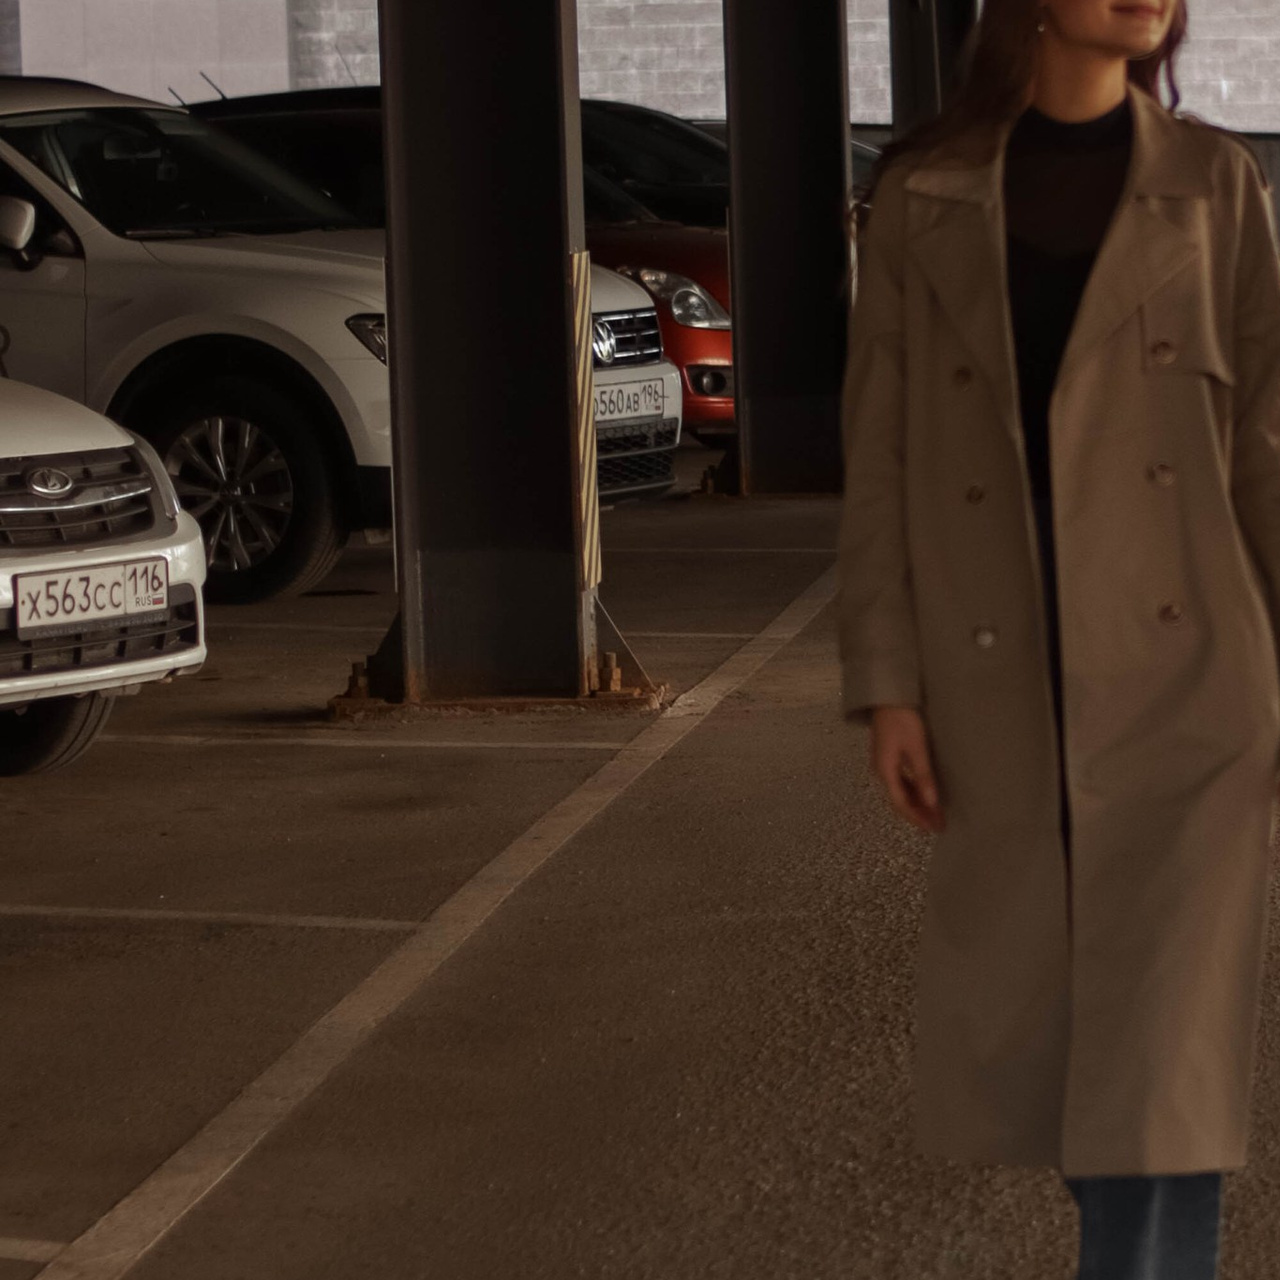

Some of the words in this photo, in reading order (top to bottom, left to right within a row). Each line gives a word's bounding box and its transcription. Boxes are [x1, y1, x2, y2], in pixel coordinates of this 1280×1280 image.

[642, 383, 659, 403] 196
[128, 564, 161, 595] 116
[135, 596, 152, 607] RUS
